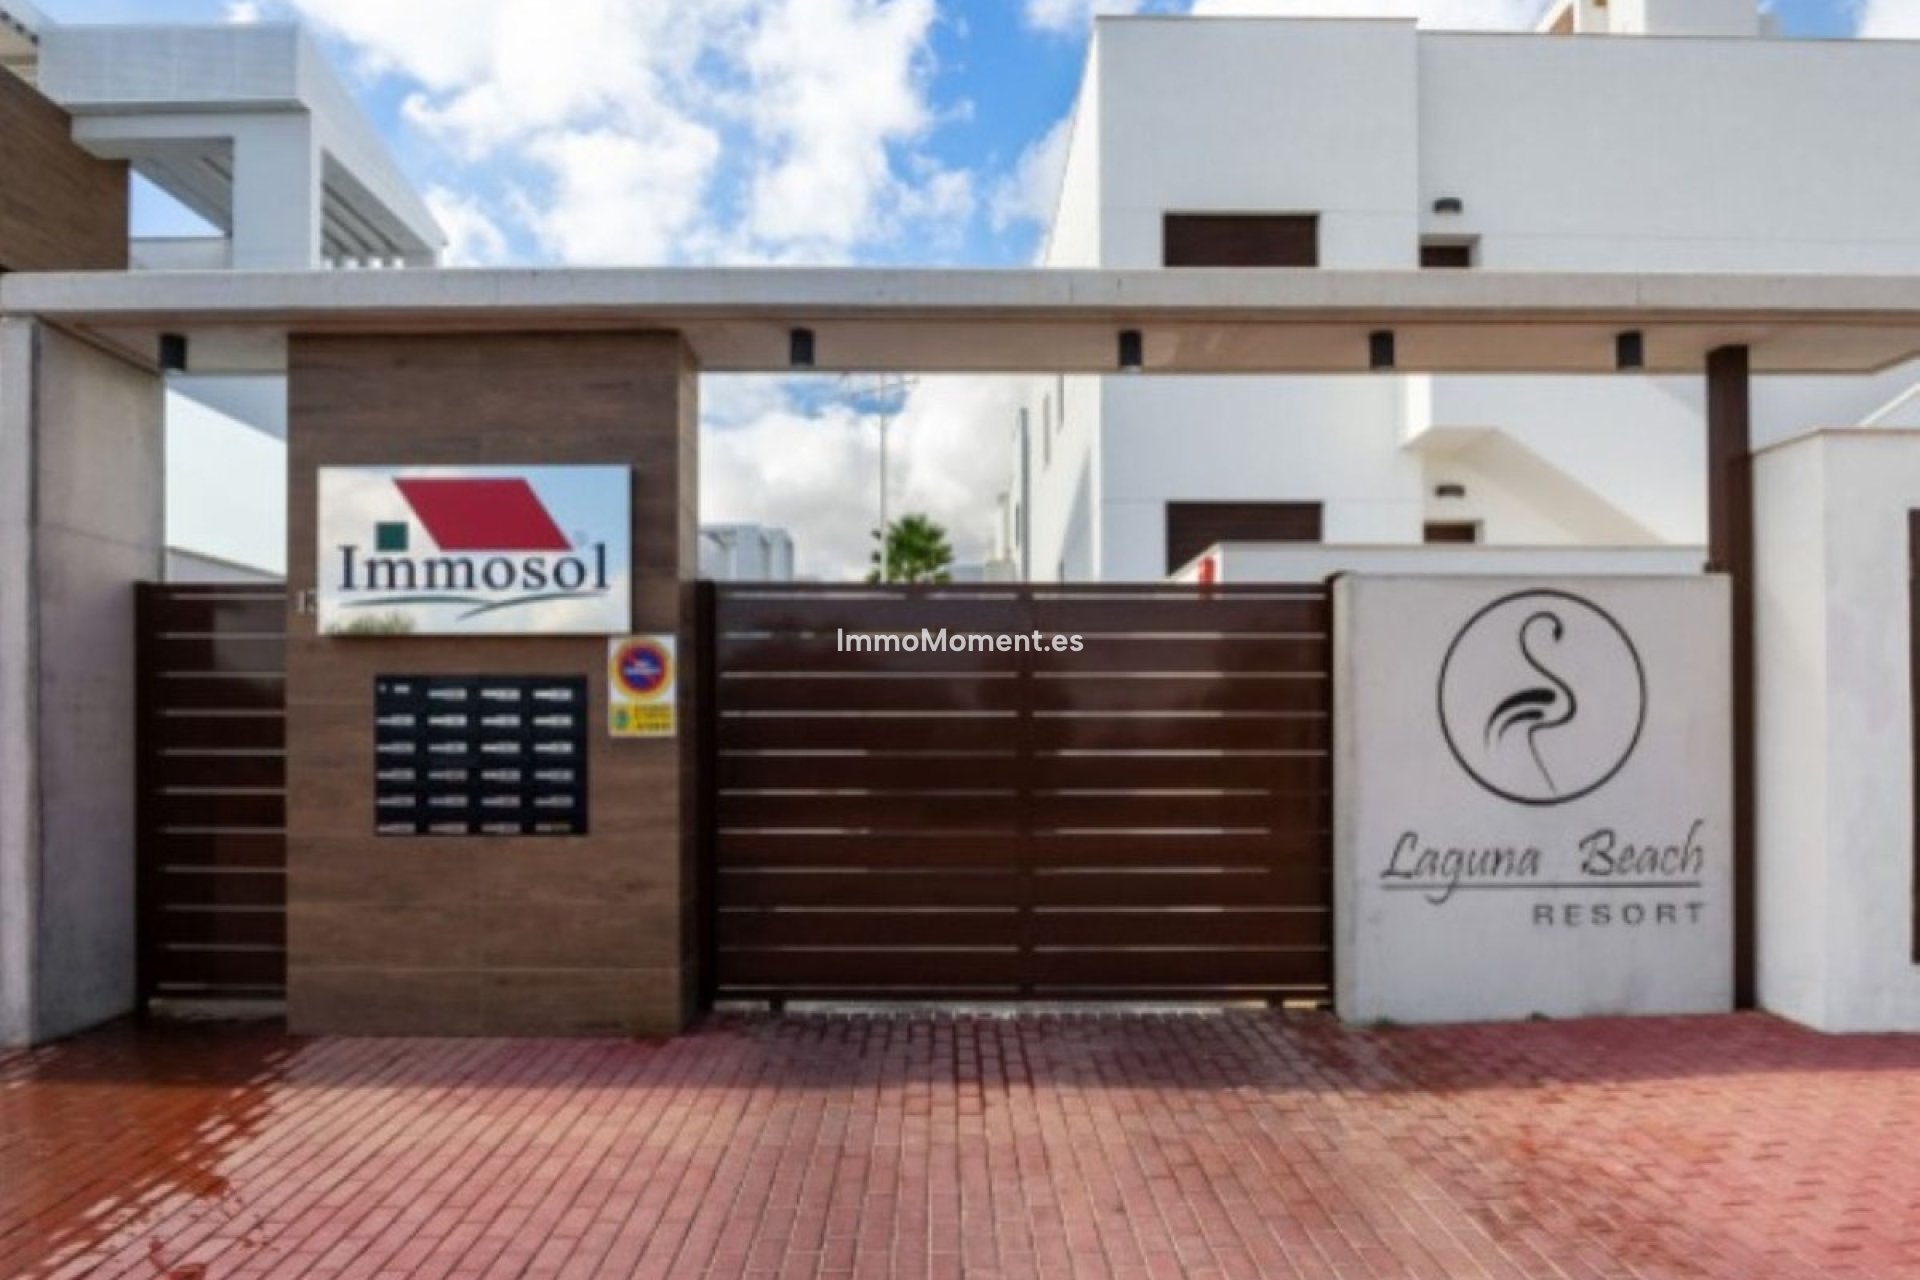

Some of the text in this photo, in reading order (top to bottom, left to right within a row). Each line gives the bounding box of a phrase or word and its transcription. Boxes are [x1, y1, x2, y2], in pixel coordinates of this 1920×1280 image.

[338, 543, 609, 591] Immosol
[1380, 819, 1704, 905] Laguna Beach
[1532, 903, 1704, 926] RESORT
